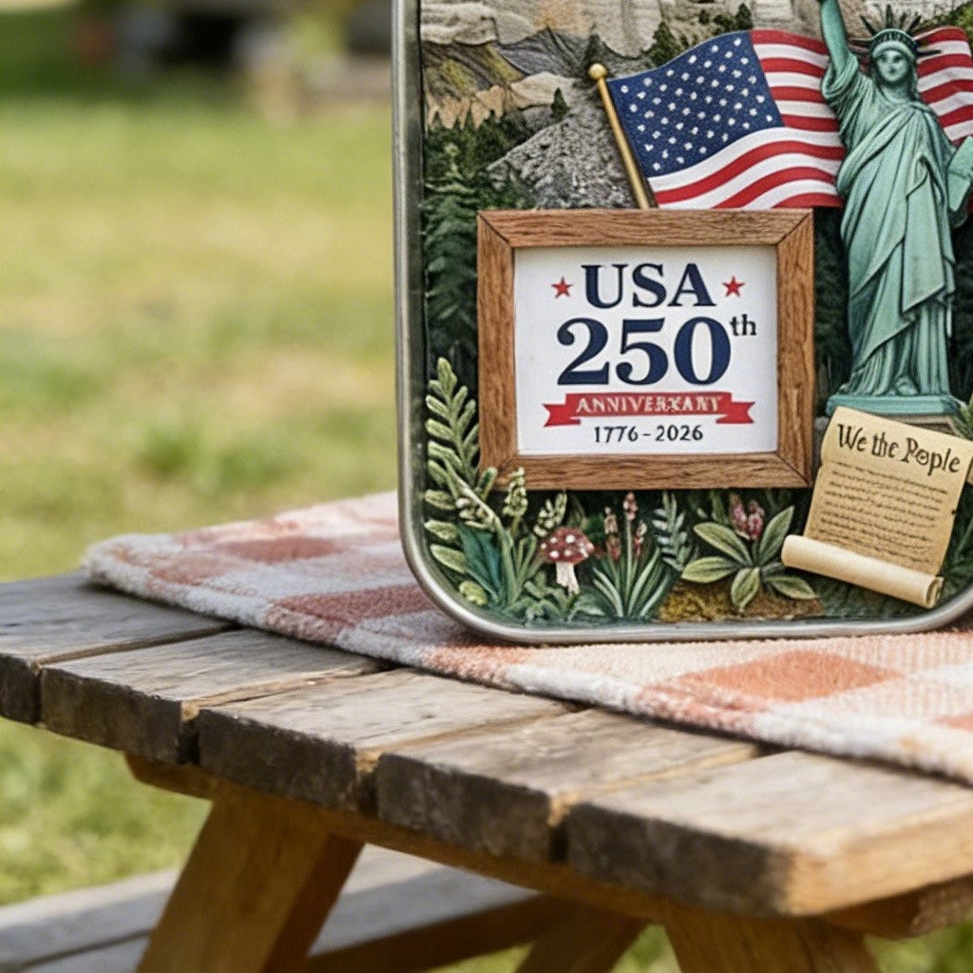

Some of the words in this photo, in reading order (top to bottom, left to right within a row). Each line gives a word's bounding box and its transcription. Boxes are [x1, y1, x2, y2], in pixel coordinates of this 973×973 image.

[581, 263, 717, 309] USA
[557, 313, 757, 386] 250th
[838, 423, 867, 452] We
[871, 432, 899, 459] the
